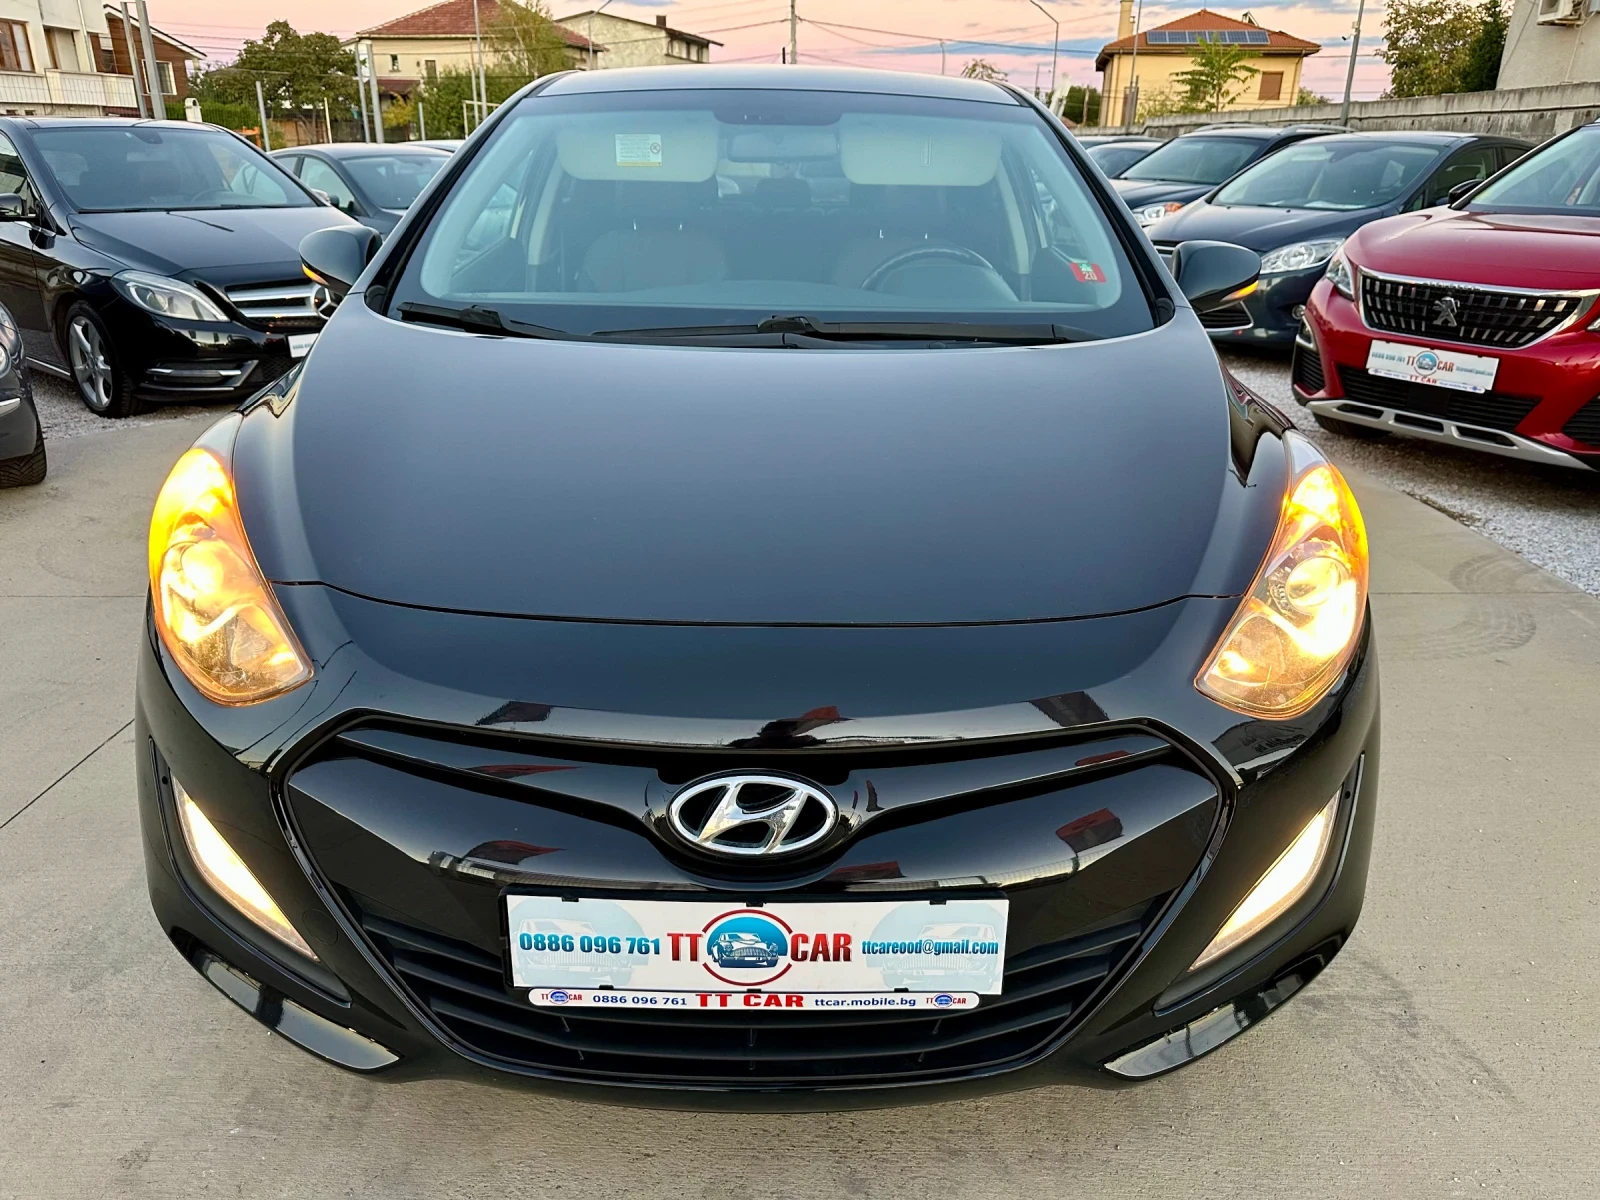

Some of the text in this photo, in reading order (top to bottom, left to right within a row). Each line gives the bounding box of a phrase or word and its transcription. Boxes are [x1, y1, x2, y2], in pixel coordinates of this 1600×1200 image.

[1406, 355, 1416, 366] TT
[1437, 360, 1455, 373] CAR
[1421, 376, 1437, 384] CAR
[519, 932, 999, 962] 0886 096 761 TT CAR ttcareood@gmail.com
[592, 995, 627, 1004] 0886
[631, 996, 658, 1005] 096
[662, 997, 687, 1005] 761
[695, 993, 732, 1007] TT
[743, 994, 804, 1008] CAR
[814, 997, 916, 1006] ttcar.mobile.bg
